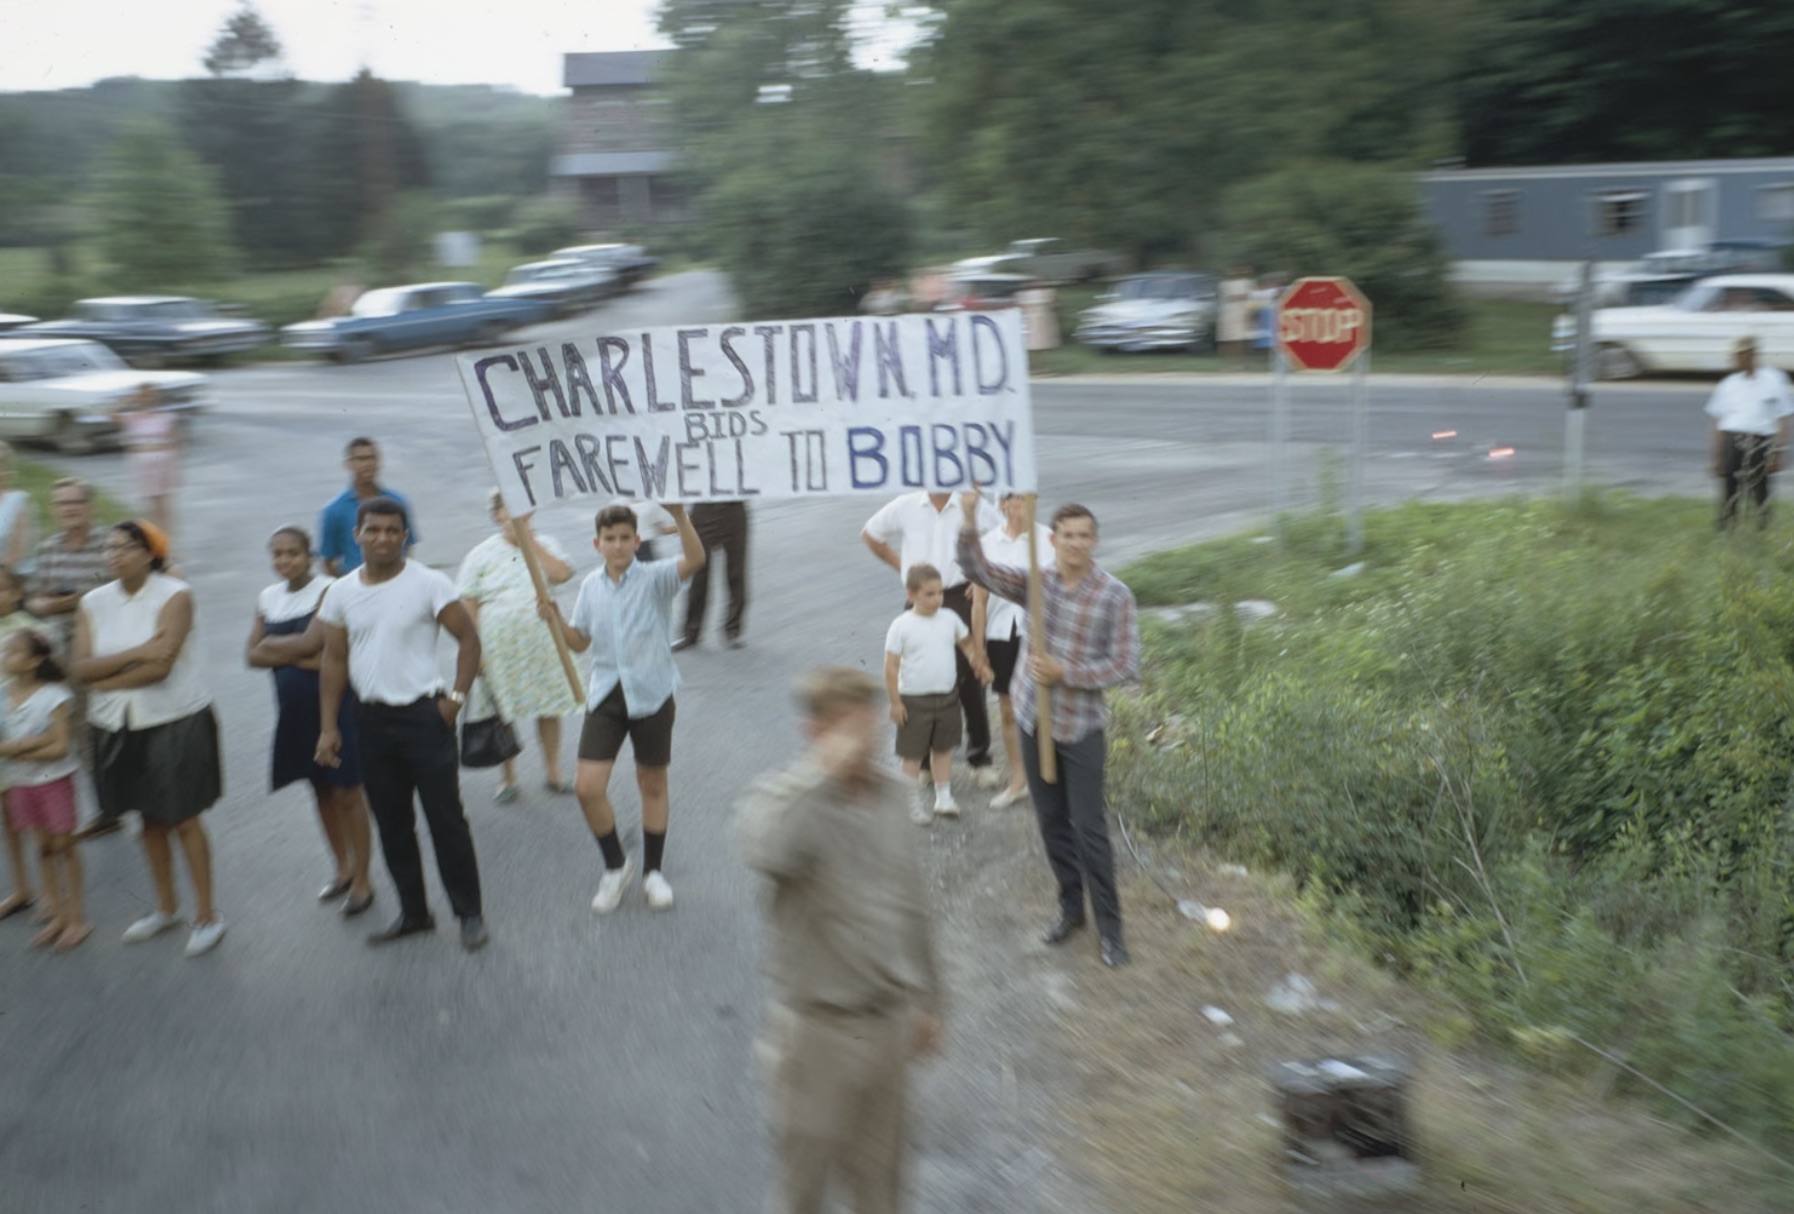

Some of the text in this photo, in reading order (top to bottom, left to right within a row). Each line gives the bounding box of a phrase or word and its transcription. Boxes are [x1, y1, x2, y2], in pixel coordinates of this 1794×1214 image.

[1280, 307, 1363, 343] STOP
[684, 410, 768, 444] BIDS
[512, 420, 1016, 507] FAREWELL TO BOBBY
